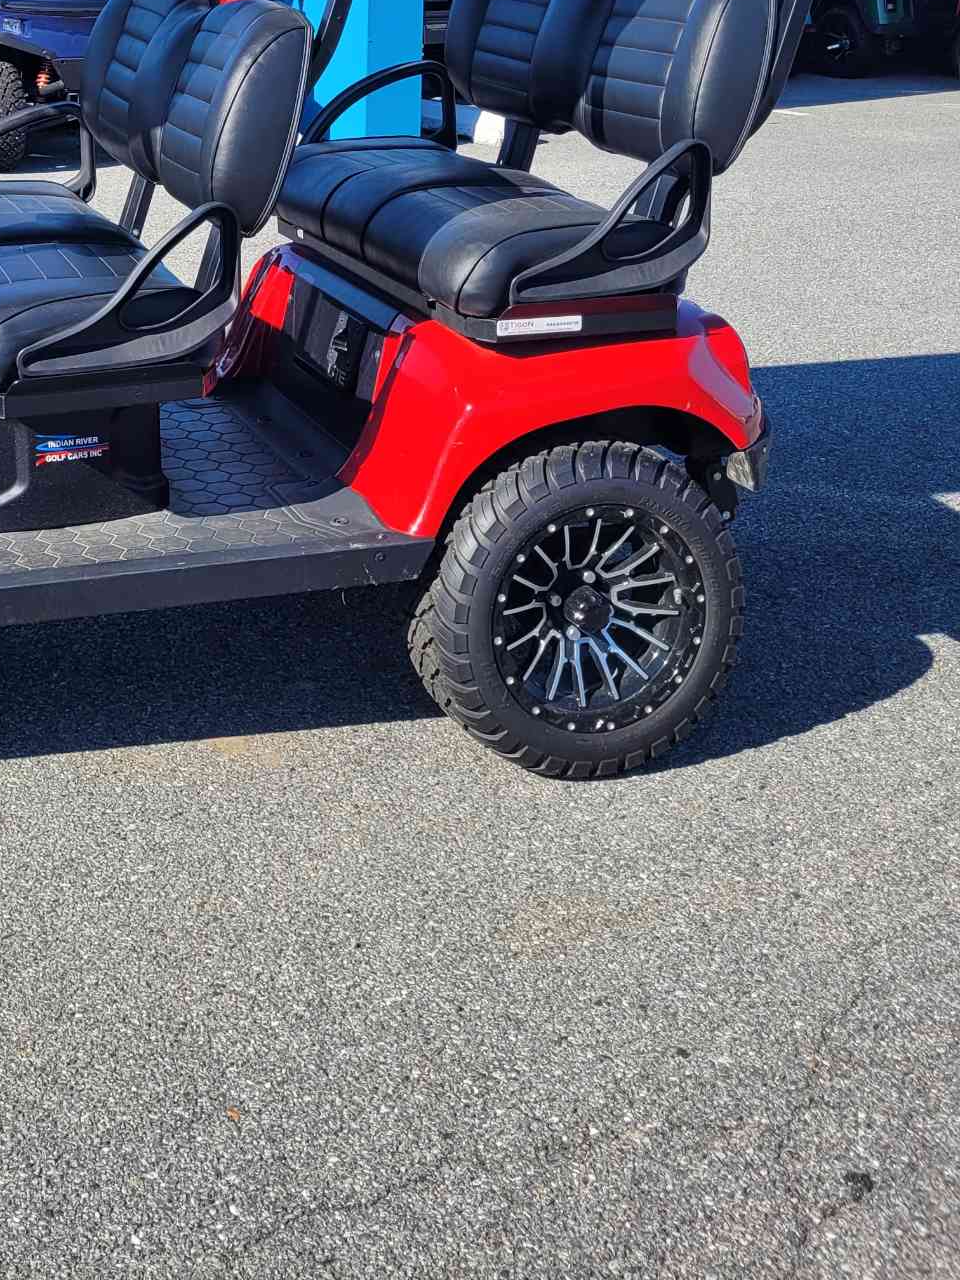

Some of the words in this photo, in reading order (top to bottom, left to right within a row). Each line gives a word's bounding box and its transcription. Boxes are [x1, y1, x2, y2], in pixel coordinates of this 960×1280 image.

[47, 439, 74, 448] INDIAN
[75, 436, 98, 445] RIVER
[45, 454, 66, 462] GOLF
